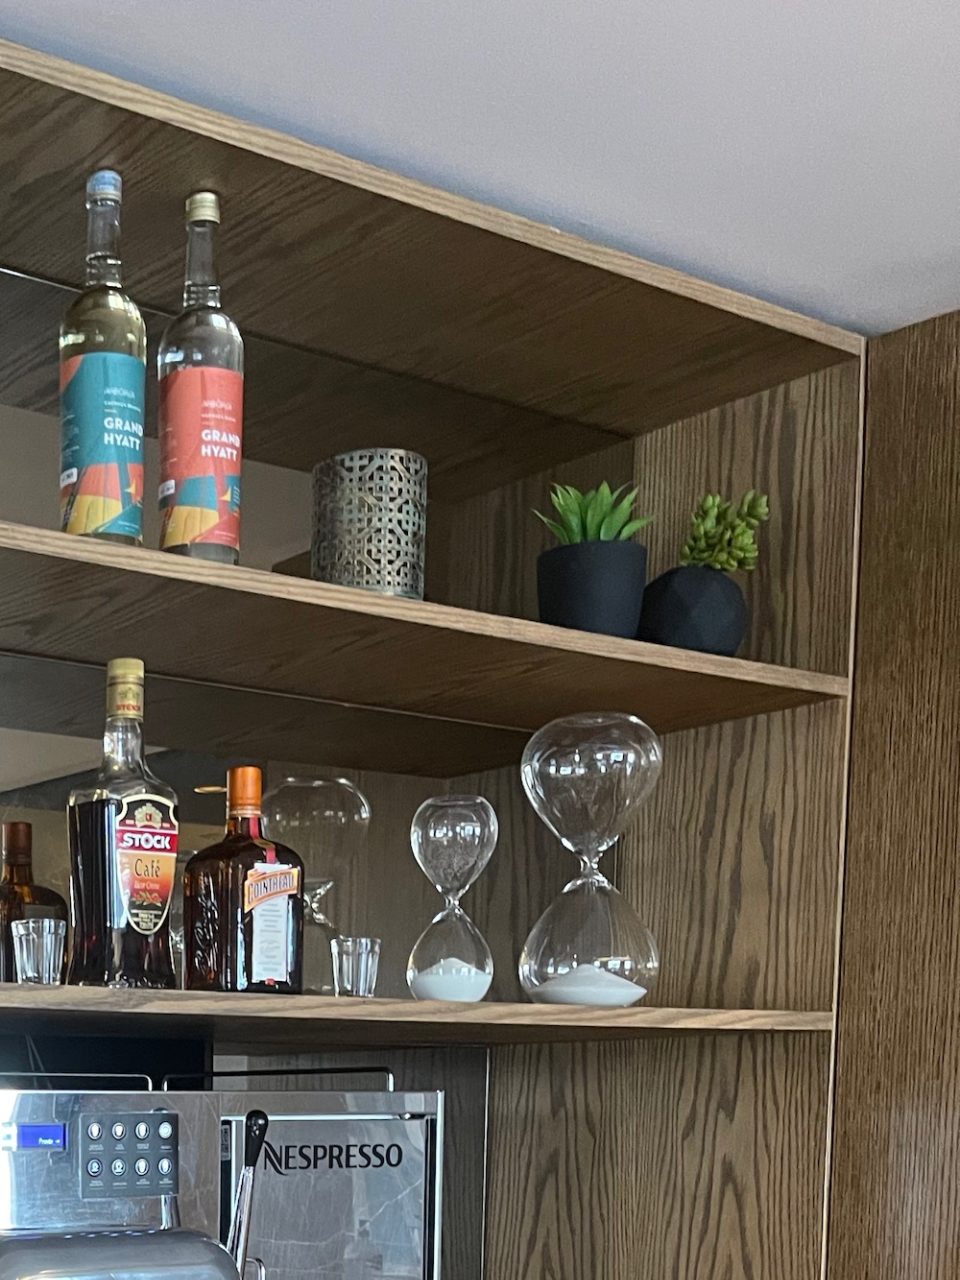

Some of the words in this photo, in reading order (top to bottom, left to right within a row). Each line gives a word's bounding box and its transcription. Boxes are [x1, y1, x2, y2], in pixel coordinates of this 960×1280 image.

[103, 417, 144, 437] GRAND
[103, 432, 140, 451] HYATT
[201, 429, 240, 448] GRAND
[201, 444, 237, 461] HYATT
[120, 832, 171, 850] STOCK
[134, 858, 161, 878] Café
[248, 873, 294, 904] COINTREAU
[263, 1140, 404, 1176] NESPRESSO
